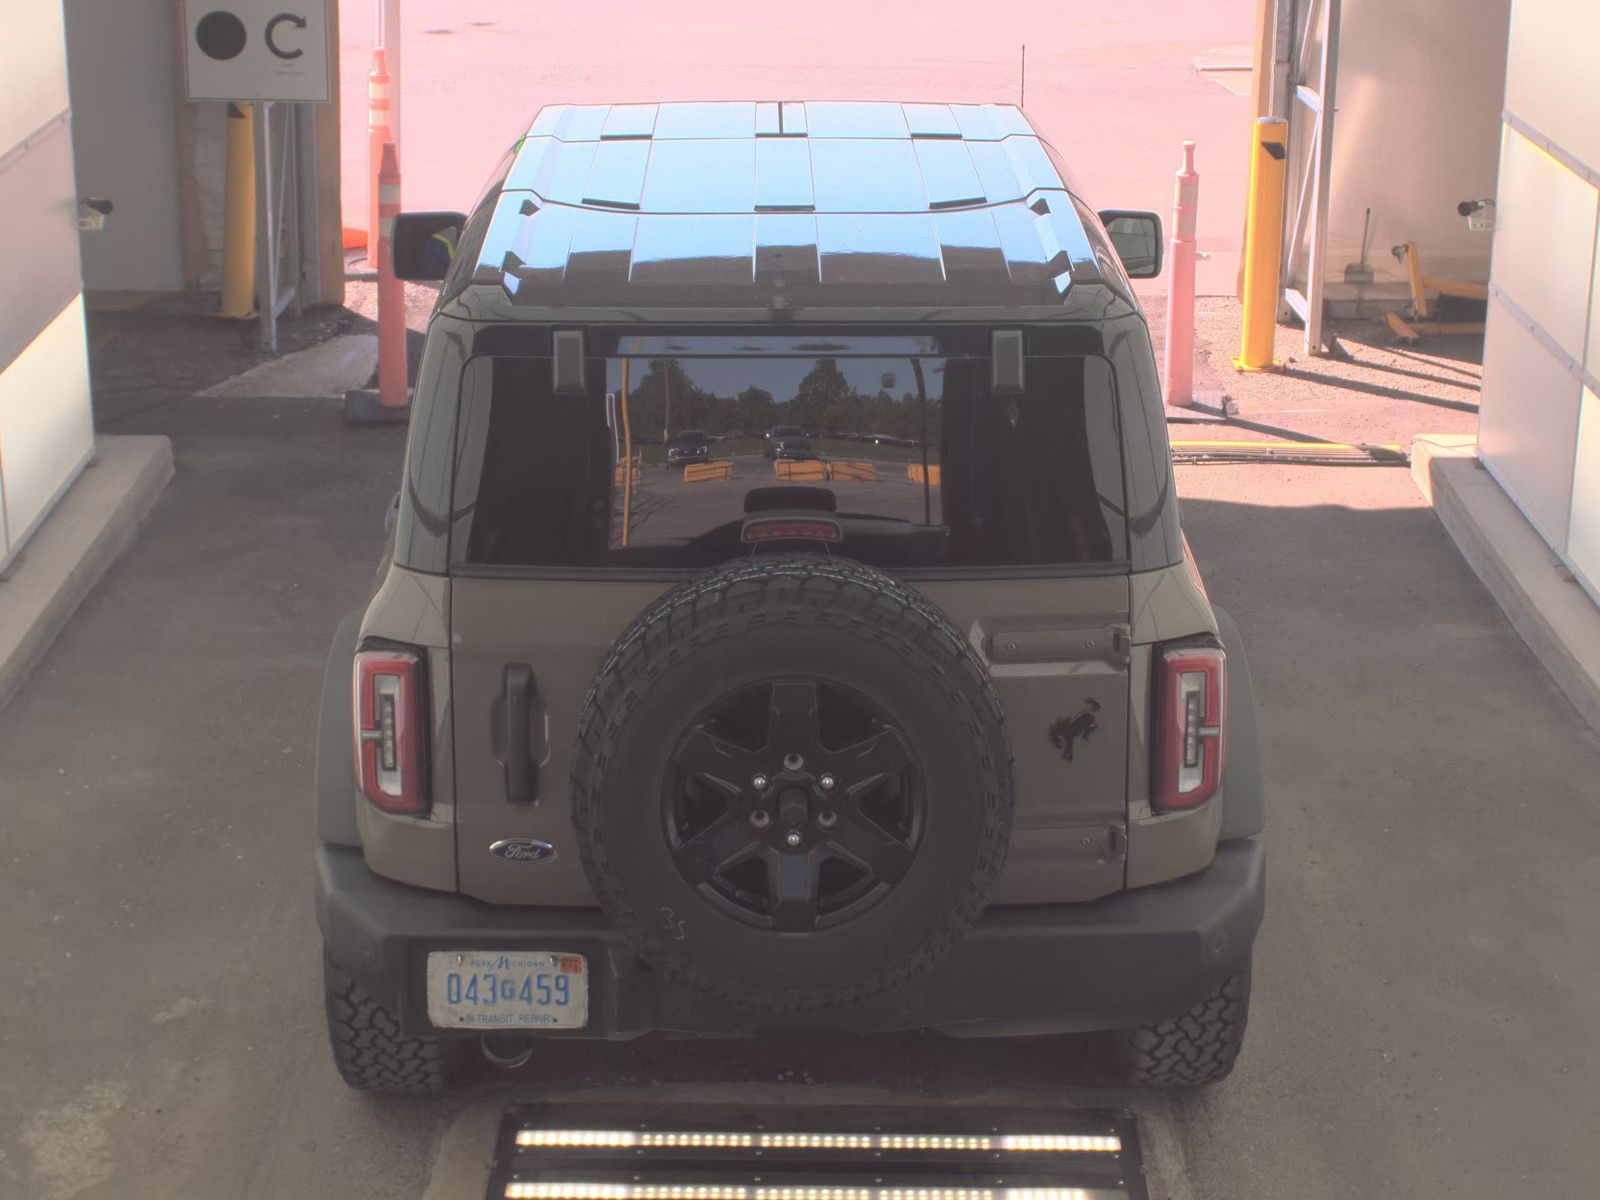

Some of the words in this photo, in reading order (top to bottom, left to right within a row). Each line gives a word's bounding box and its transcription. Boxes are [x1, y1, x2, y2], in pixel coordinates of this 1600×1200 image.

[504, 842, 542, 860] Ford
[490, 955, 545, 970] MICHIGAN
[465, 1014, 513, 1024] IN-TRANSIT
[518, 1014, 551, 1024] REPAIR
